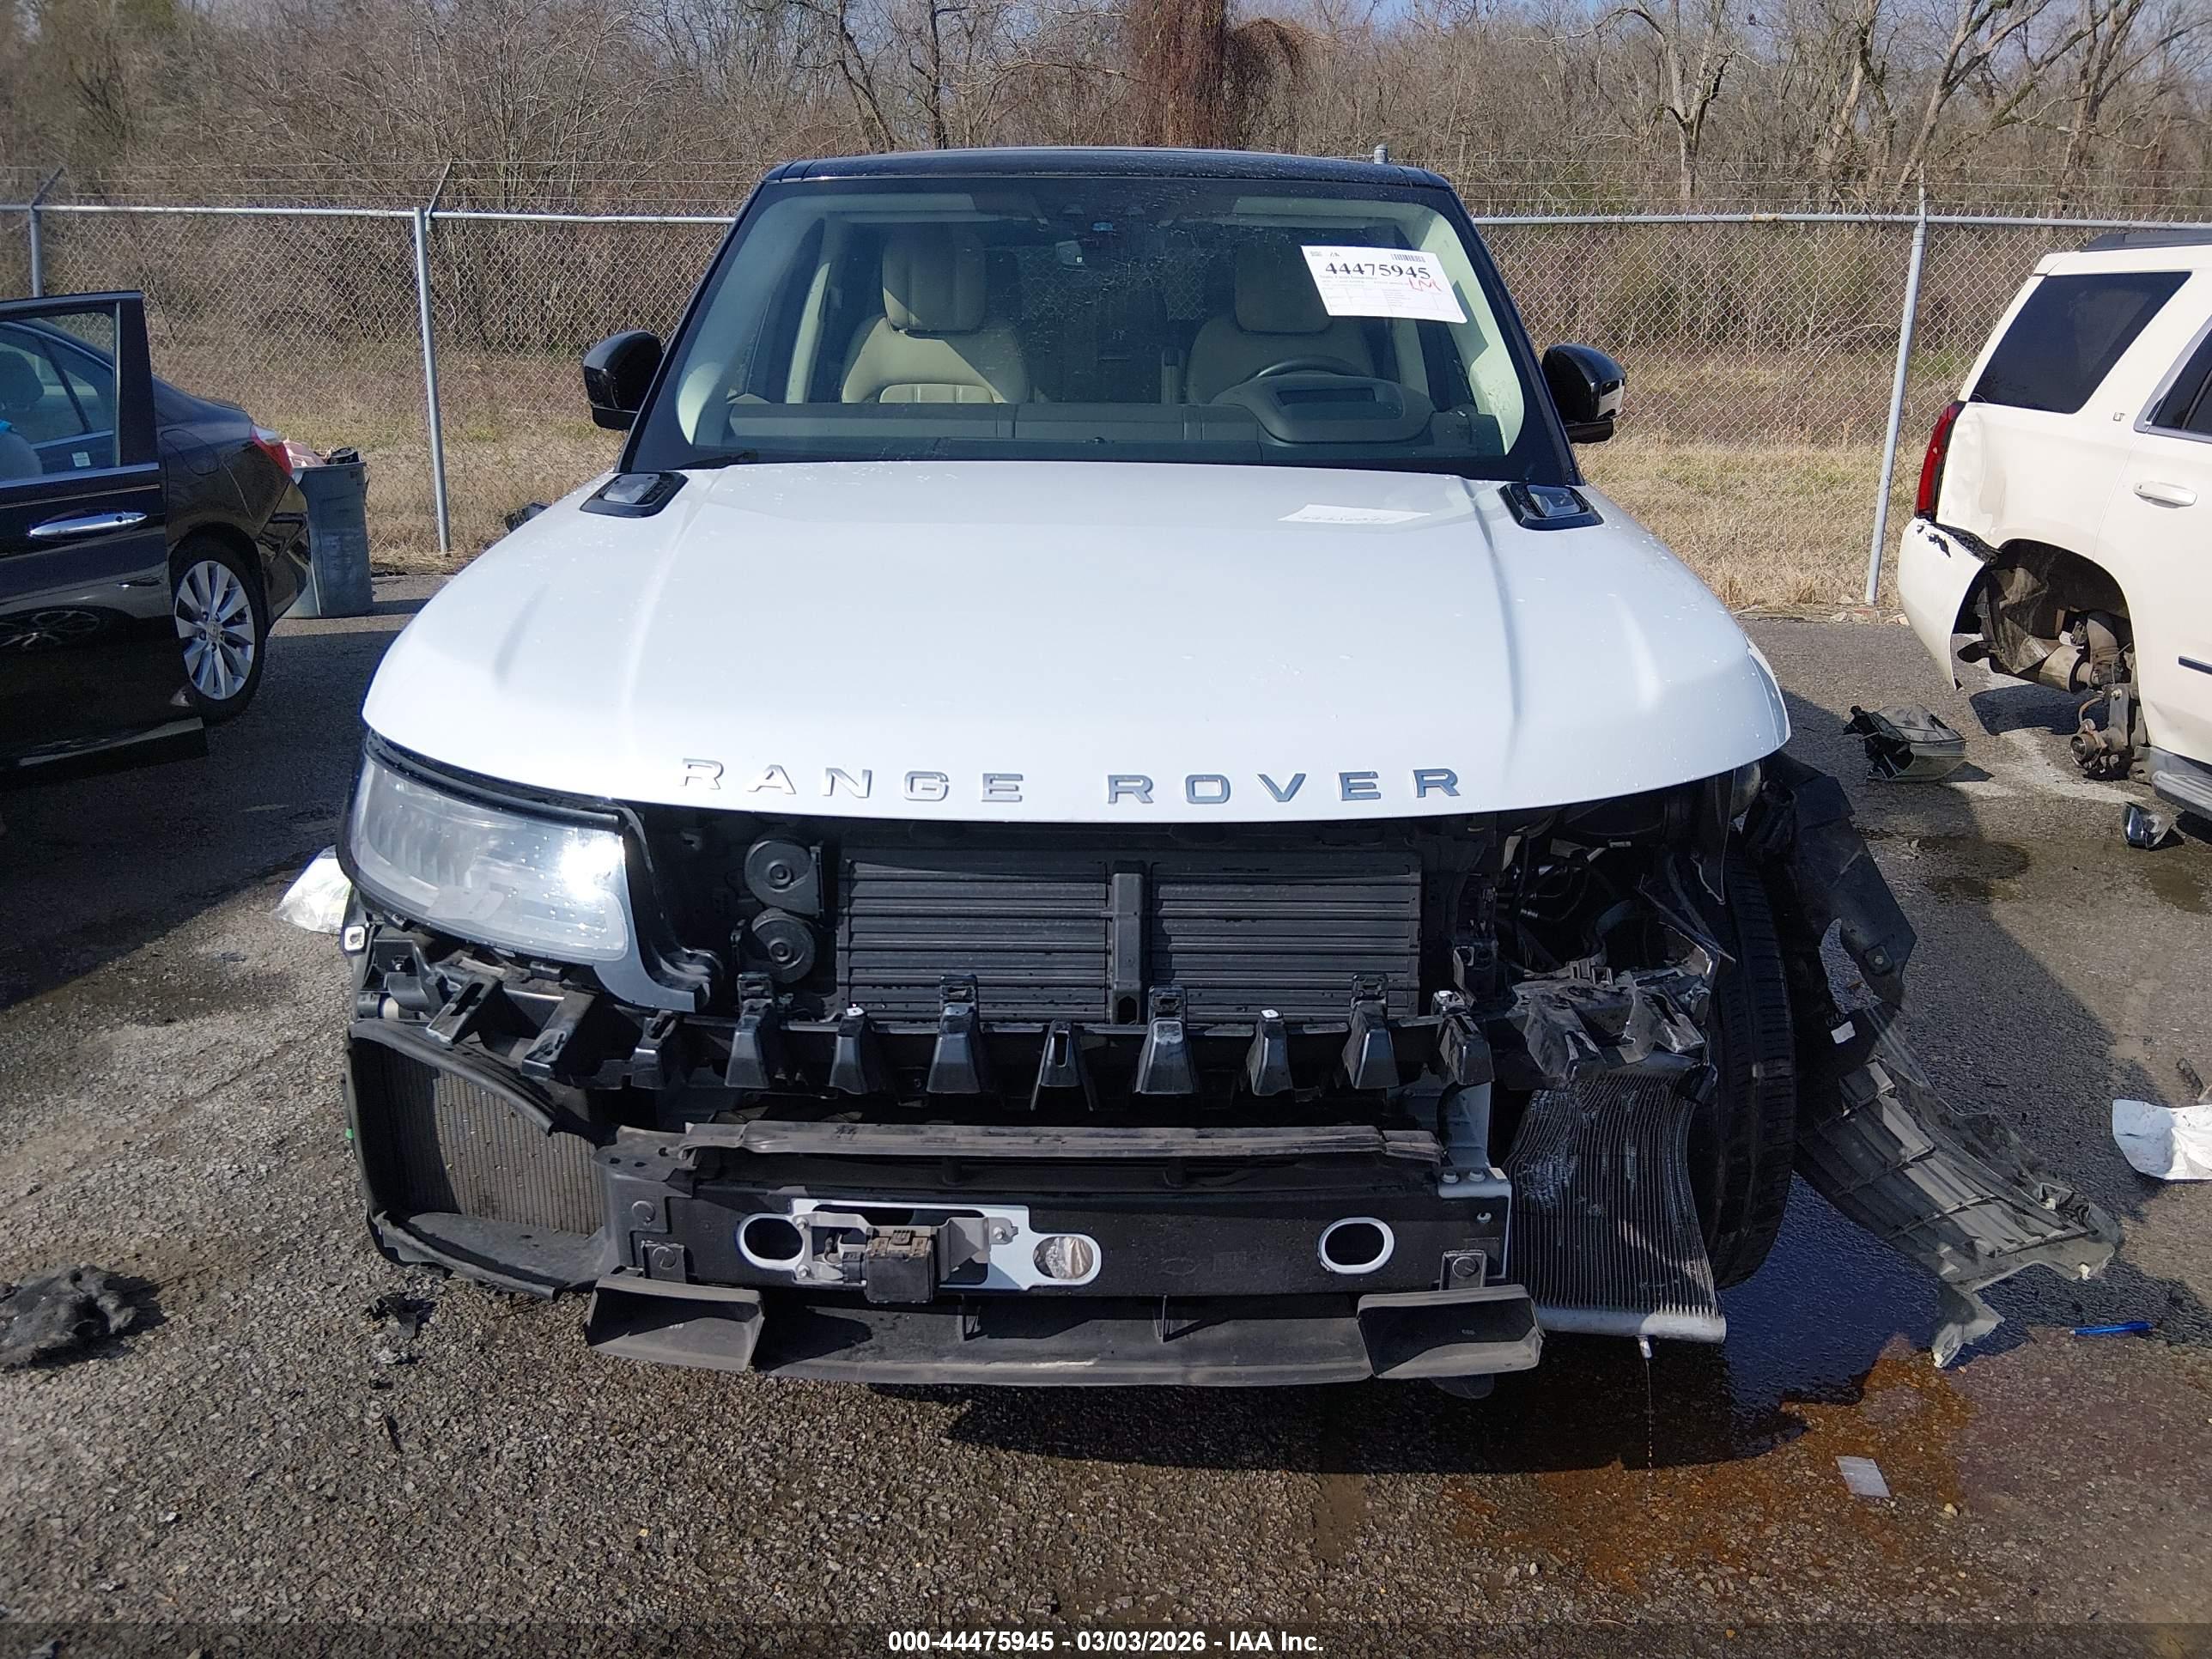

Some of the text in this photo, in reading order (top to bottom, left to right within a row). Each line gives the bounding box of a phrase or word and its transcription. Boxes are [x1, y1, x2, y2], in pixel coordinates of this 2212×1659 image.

[1325, 262, 1431, 279] 44475945
[681, 757, 1462, 804] RANGE ROVER
